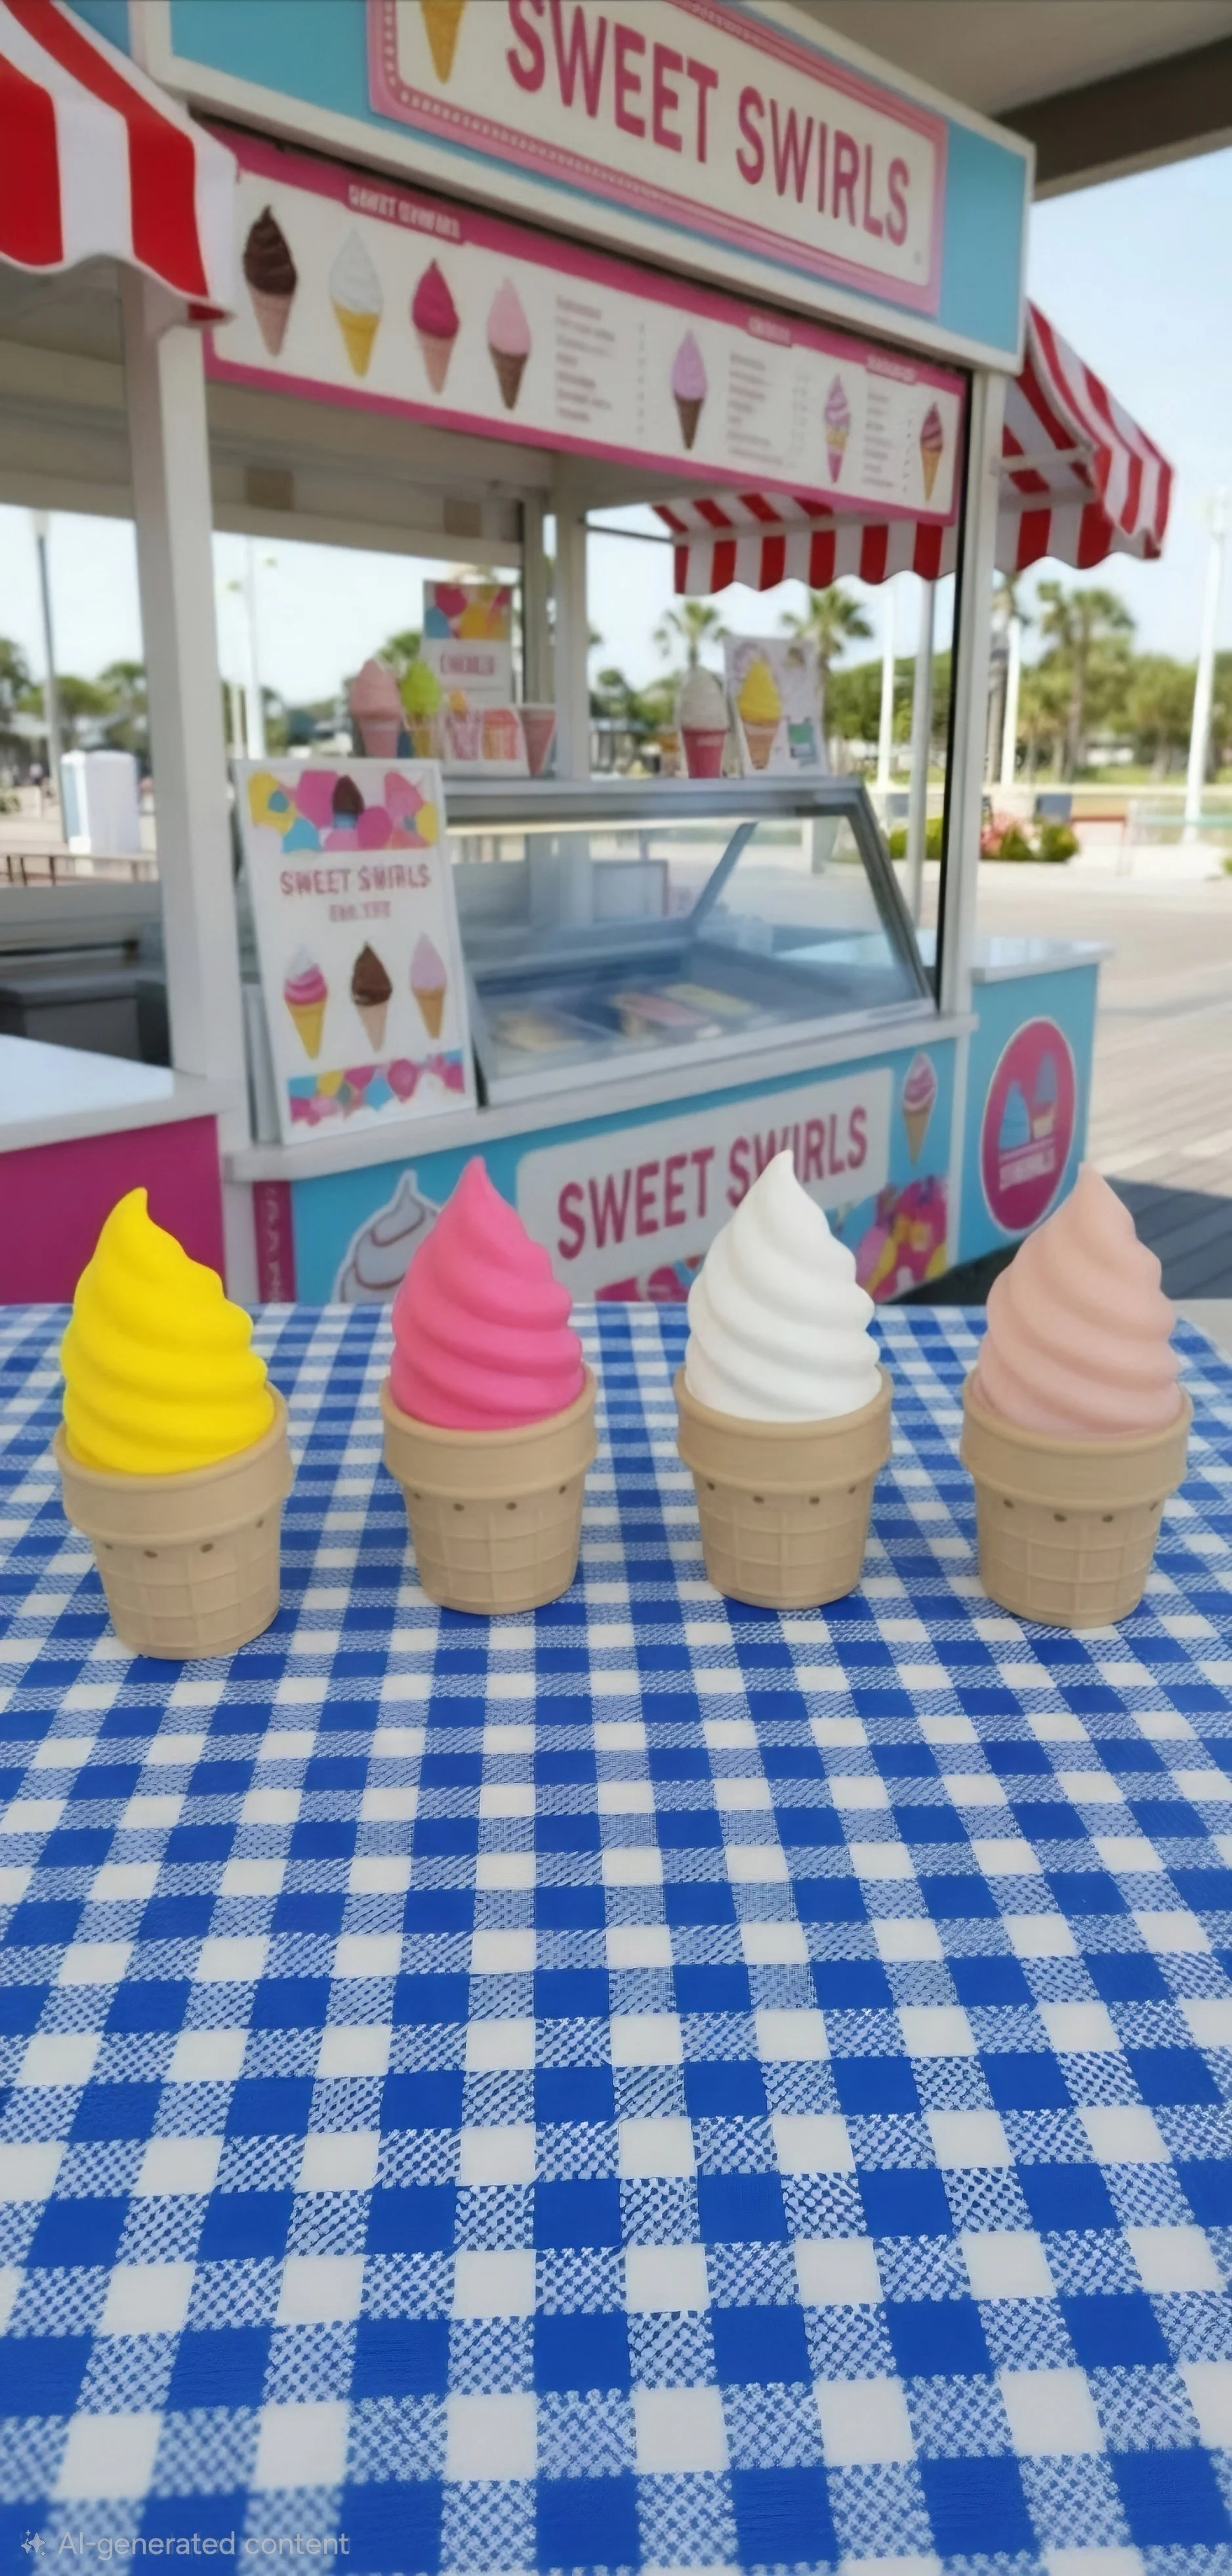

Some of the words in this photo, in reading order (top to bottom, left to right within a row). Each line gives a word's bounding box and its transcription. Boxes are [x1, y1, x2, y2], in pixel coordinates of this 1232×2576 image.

[506, 0, 718, 164] SWEET
[736, 85, 910, 247] SWIRLS
[558, 1146, 715, 1260] SWEET
